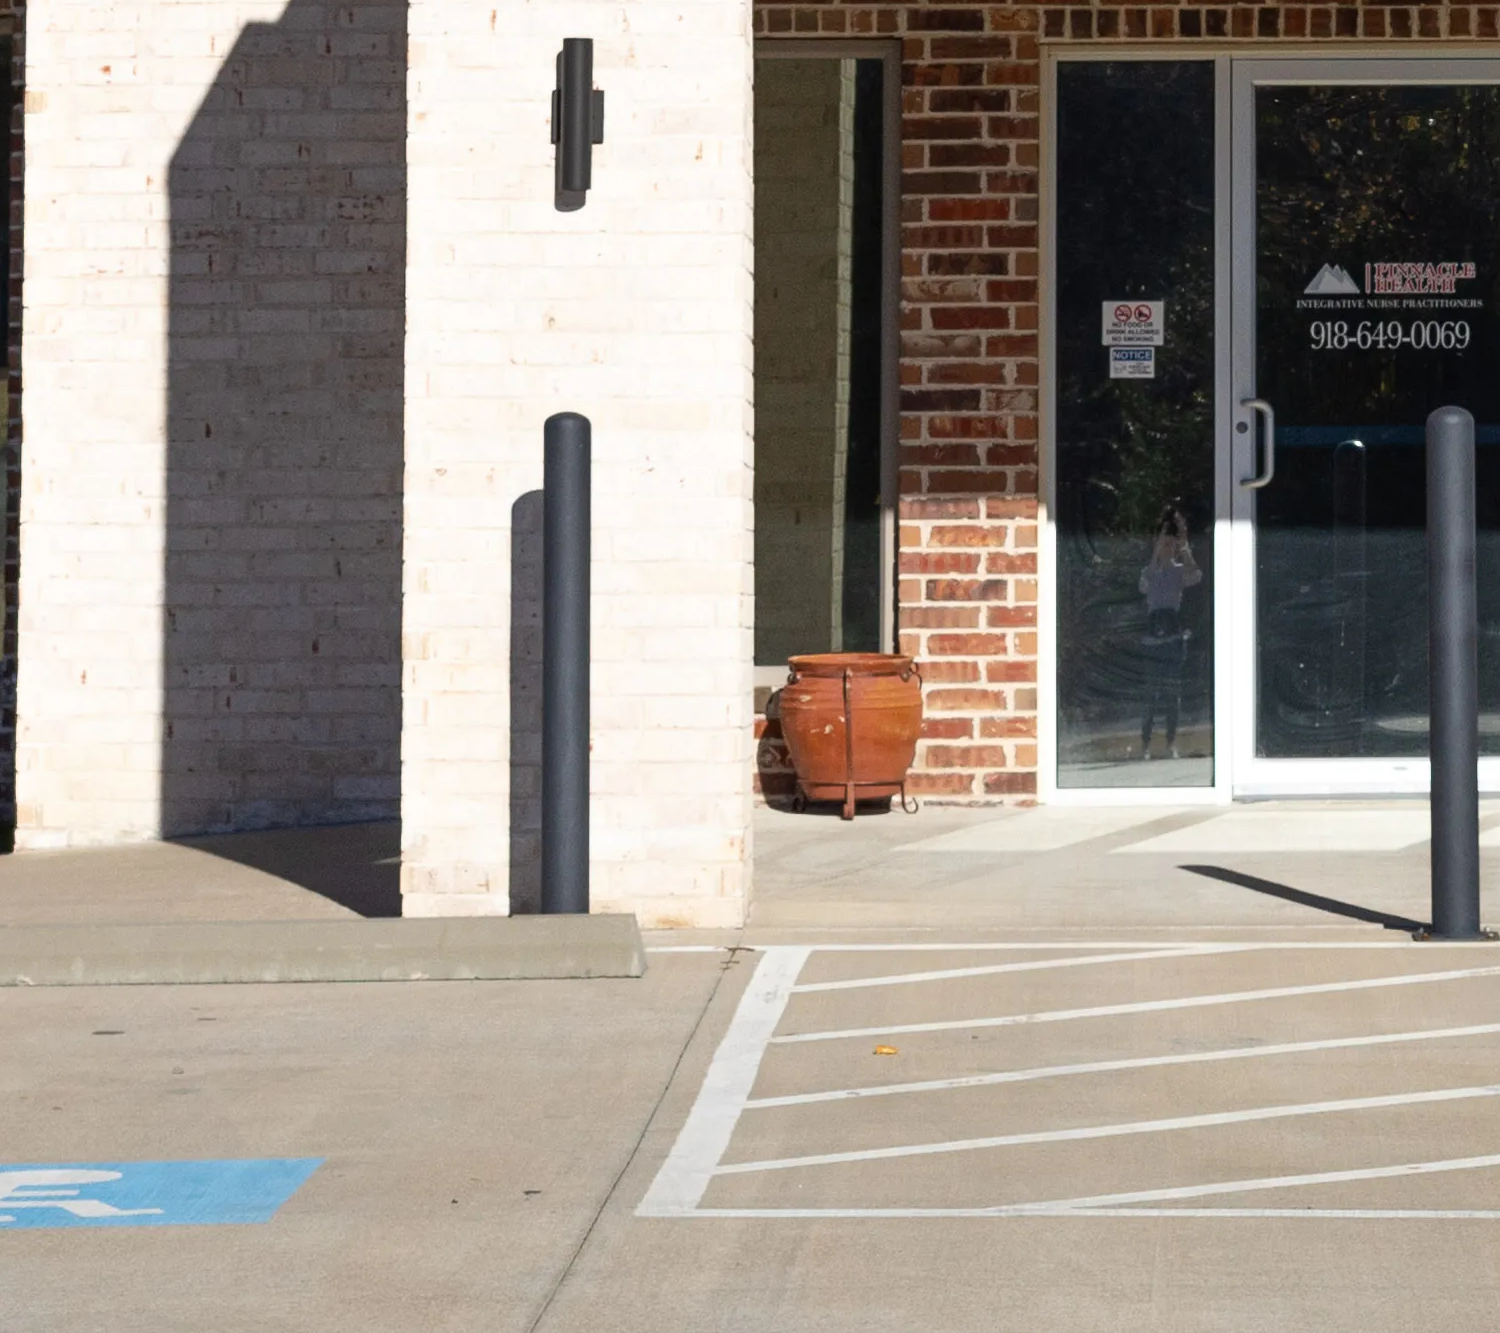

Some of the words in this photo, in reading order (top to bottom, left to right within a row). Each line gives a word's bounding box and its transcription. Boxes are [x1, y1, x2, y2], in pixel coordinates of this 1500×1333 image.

[1373, 262, 1476, 278] PINNACLE
[1373, 278, 1456, 293] HEALTH
[1296, 299, 1365, 309] INTEGRATIVE
[1367, 299, 1400, 309] NURSE
[1403, 299, 1483, 308] PRACTITIONERS
[1310, 321, 1471, 349] 918-649-0069
[1112, 351, 1151, 360] NOTICE
